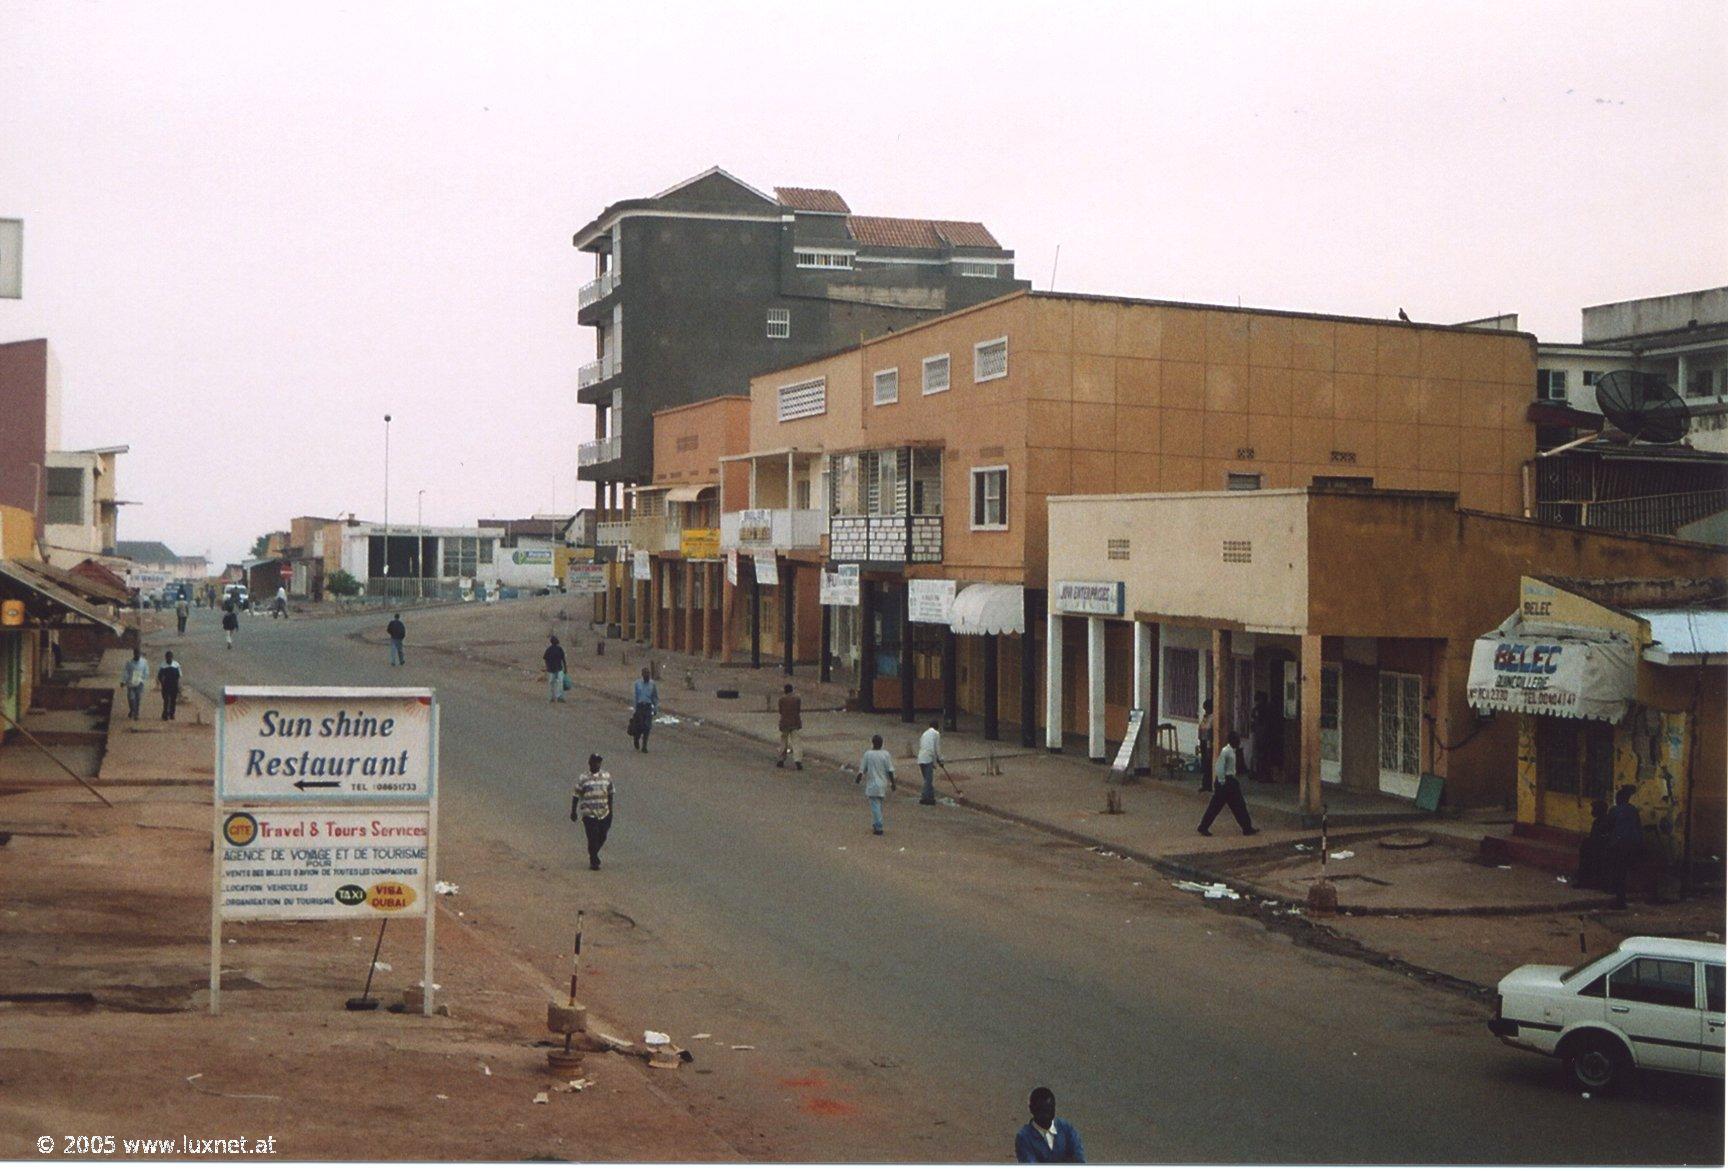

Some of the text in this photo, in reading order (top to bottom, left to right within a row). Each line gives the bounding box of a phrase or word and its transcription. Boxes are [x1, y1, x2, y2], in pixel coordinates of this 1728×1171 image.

[1524, 601, 1551, 616] BELEC
[1494, 643, 1563, 674] BELEC
[259, 709, 395, 738] Sun shine
[246, 748, 409, 777] Restaurant
[259, 821, 427, 838] Travel & Tours Services
[224, 848, 427, 861] AGENCE DE VOYAGE ET DE TOURISME
[226, 884, 263, 892] LOCATION
[338, 890, 363, 900] TAXI
[296, 897, 335, 906] TOURISME
[372, 899, 406, 908] DUBAI
